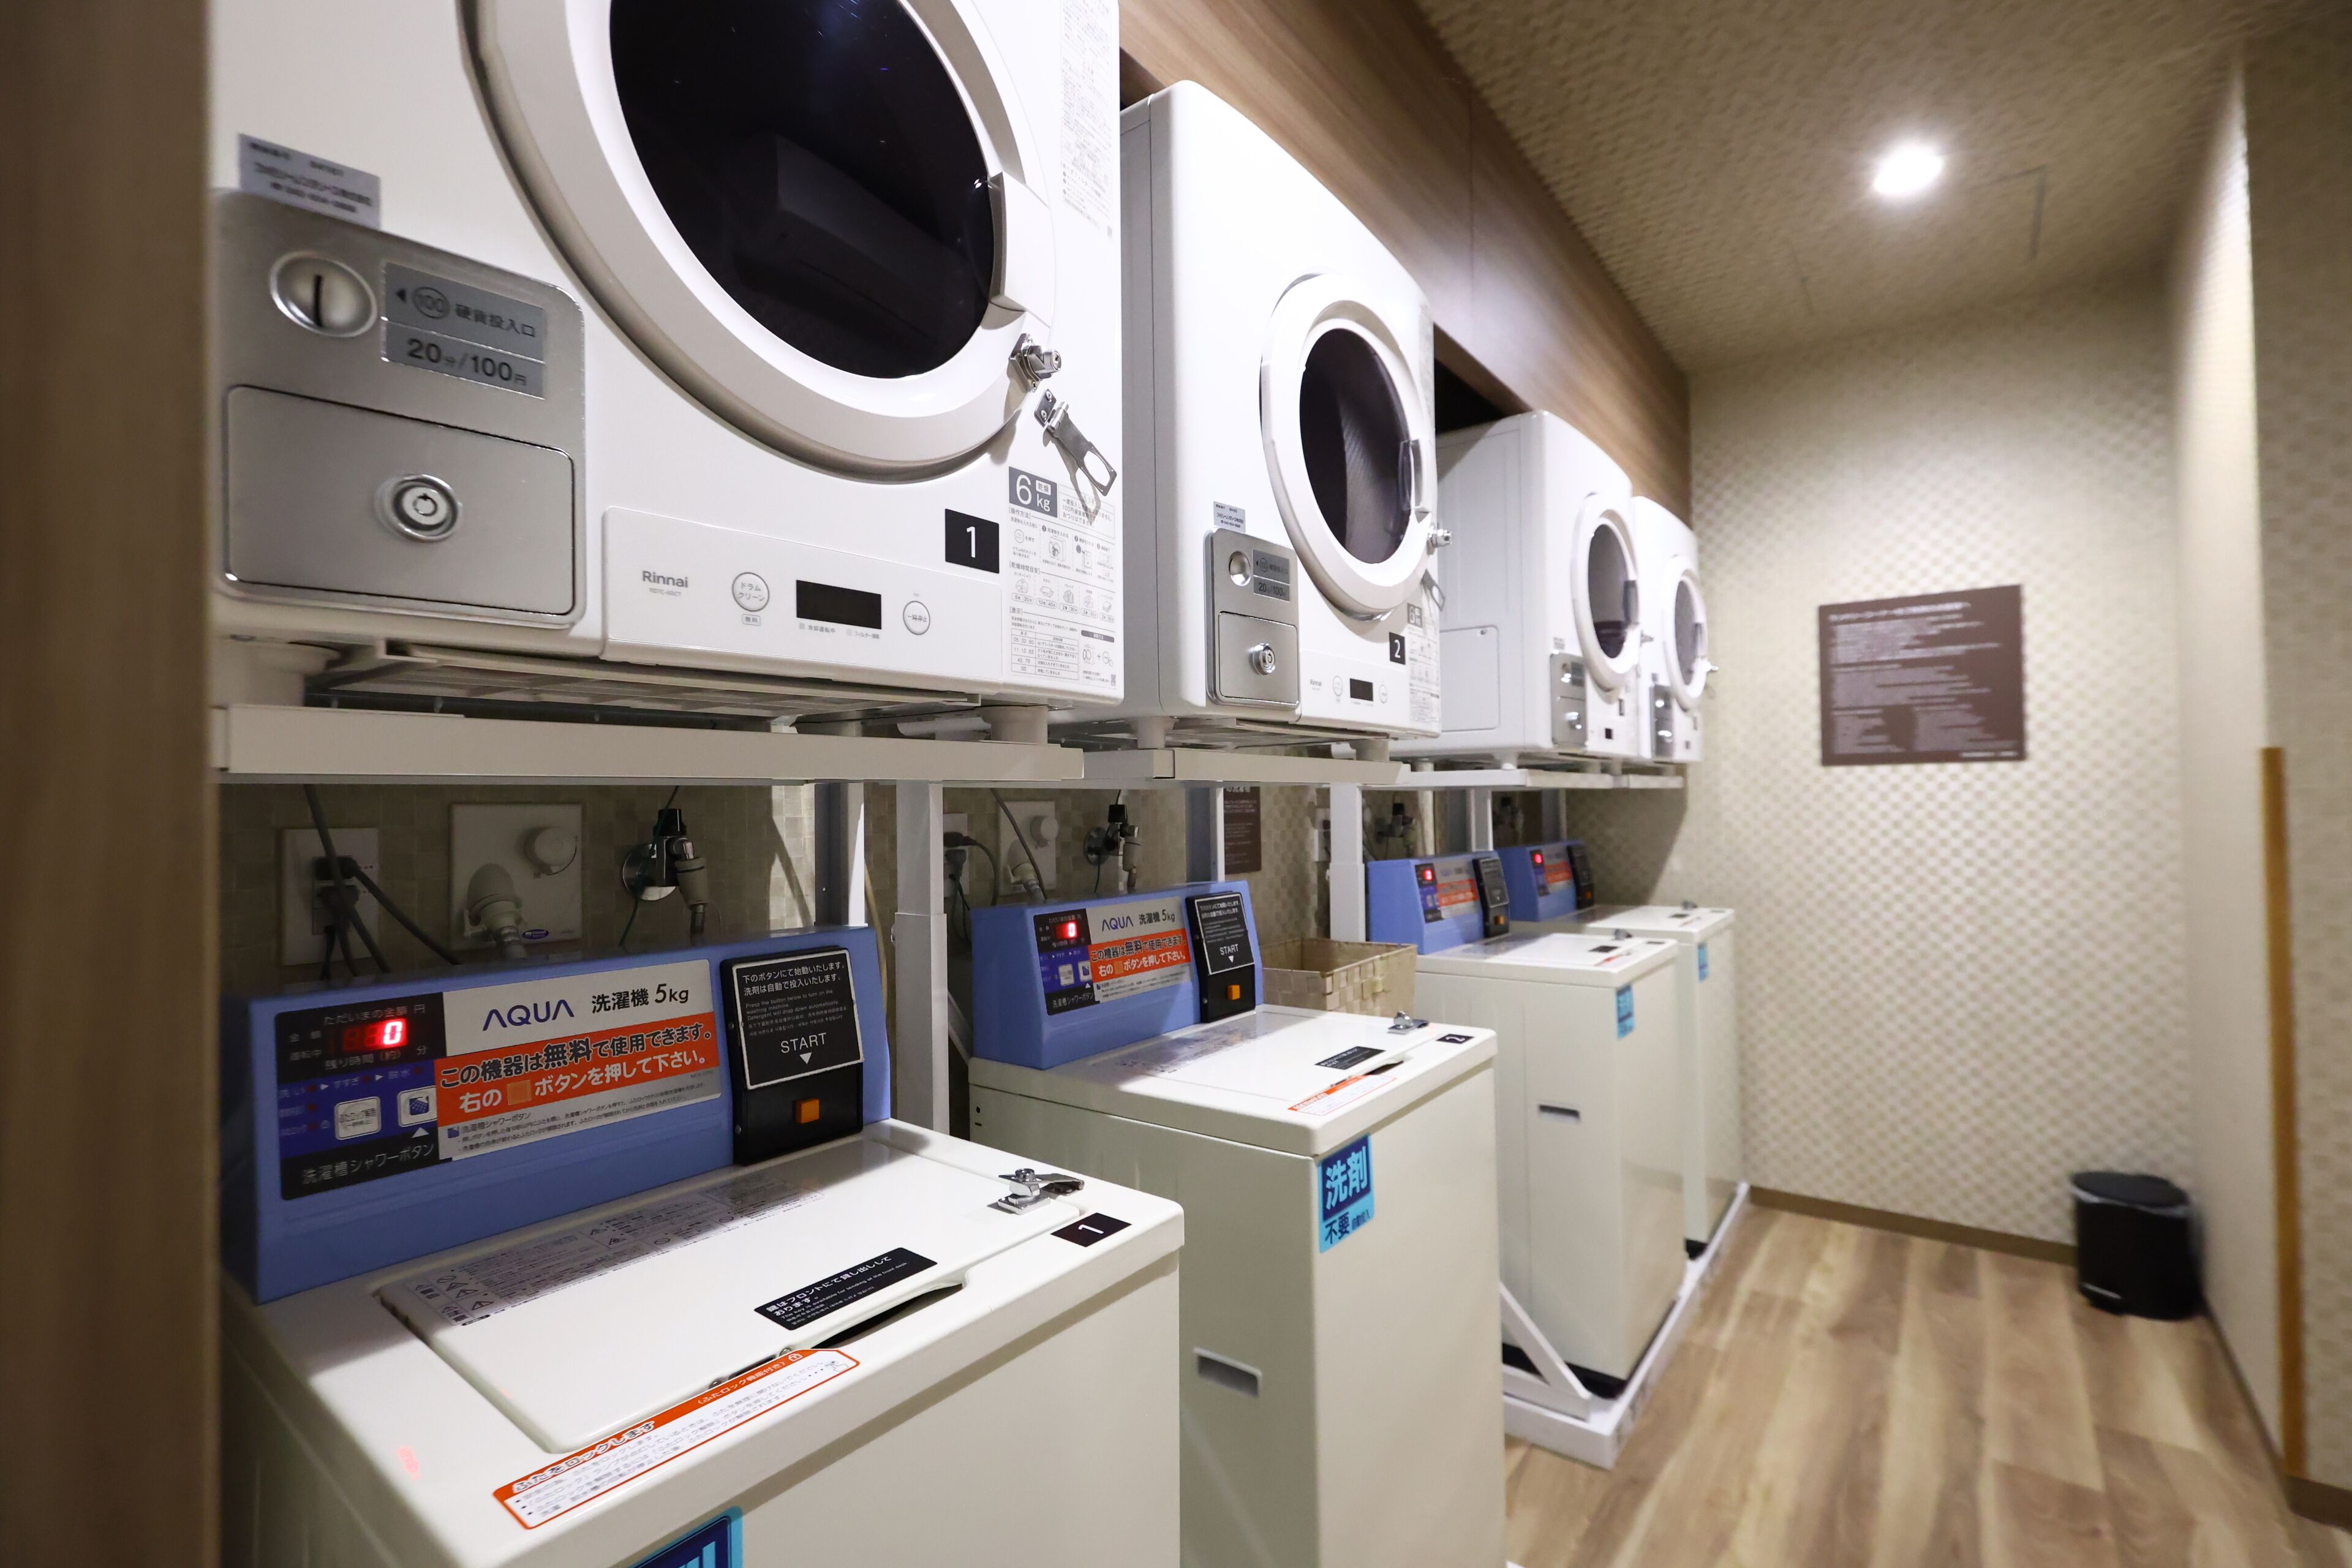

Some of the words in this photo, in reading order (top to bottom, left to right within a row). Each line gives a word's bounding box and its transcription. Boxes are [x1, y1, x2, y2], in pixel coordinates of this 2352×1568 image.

[455, 303, 536, 338] 硬貨投入口
[1016, 475, 1032, 505] 6
[1037, 482, 1049, 492] 乾燥
[1036, 494, 1050, 512] kg
[966, 526, 976, 558] 1
[643, 570, 688, 587] Rinnai
[741, 582, 761, 592] ドラム
[738, 592, 764, 601] クリーン
[1394, 639, 1401, 658] 2
[1102, 917, 1133, 932] AQUA
[1139, 911, 1159, 925] 洗濯機
[1162, 910, 1175, 922] 5kg
[1091, 935, 1186, 962] この機器は無料で使用できます。
[1219, 944, 1238, 956] START
[742, 961, 845, 984] 下のボタンにて始動いたします。
[1098, 965, 1114, 976] 右の
[1123, 950, 1186, 970] ボタンを押して下さい。
[414, 1004, 425, 1014] 円
[482, 998, 575, 1031] AQUA
[591, 990, 650, 1014] 洗濯機
[654, 983, 690, 1006] 5kg
[383, 1020, 402, 1045] 0
[781, 1032, 827, 1054] START
[441, 1021, 712, 1088] この機器は無料で使用できます。
[459, 1088, 502, 1113] 右の
[534, 1051, 705, 1097] ボタンを押して下さい。
[303, 1144, 434, 1185] 洗濯槽シャワーボタン
[1325, 1145, 1368, 1210] 洗剤
[1077, 1224, 1104, 1234] 1
[1324, 1212, 1350, 1245] 不要
[766, 1256, 892, 1313] 鍵はフロントにて貸し出しして
[774, 1295, 819, 1316] おります。
[512, 1421, 655, 1493] ふたをロックします
